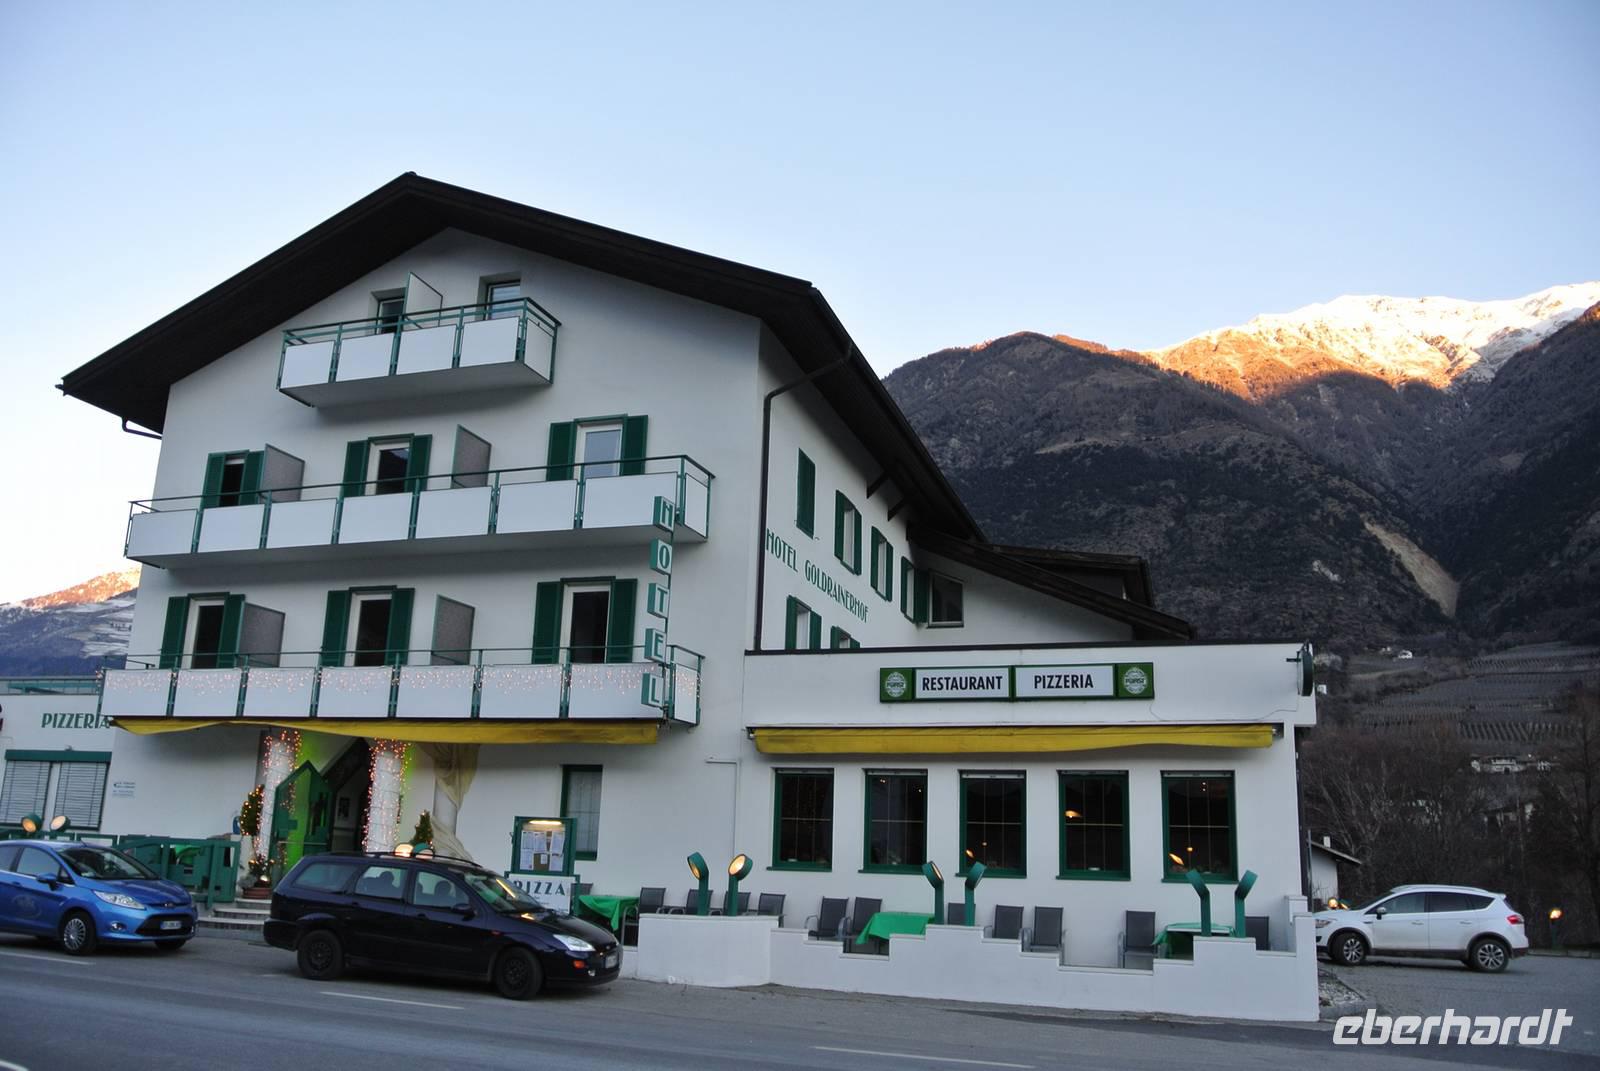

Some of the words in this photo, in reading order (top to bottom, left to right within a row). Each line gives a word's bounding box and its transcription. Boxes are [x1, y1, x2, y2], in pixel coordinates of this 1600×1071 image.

[650, 499, 673, 704] HOTEL
[765, 527, 799, 572] HOTEL
[804, 559, 870, 623] GOLDRAINERHOF
[922, 675, 1003, 691] RESTAURANT
[1033, 673, 1094, 690] PIZZERIA
[41, 712, 110, 729] PIZZERIA
